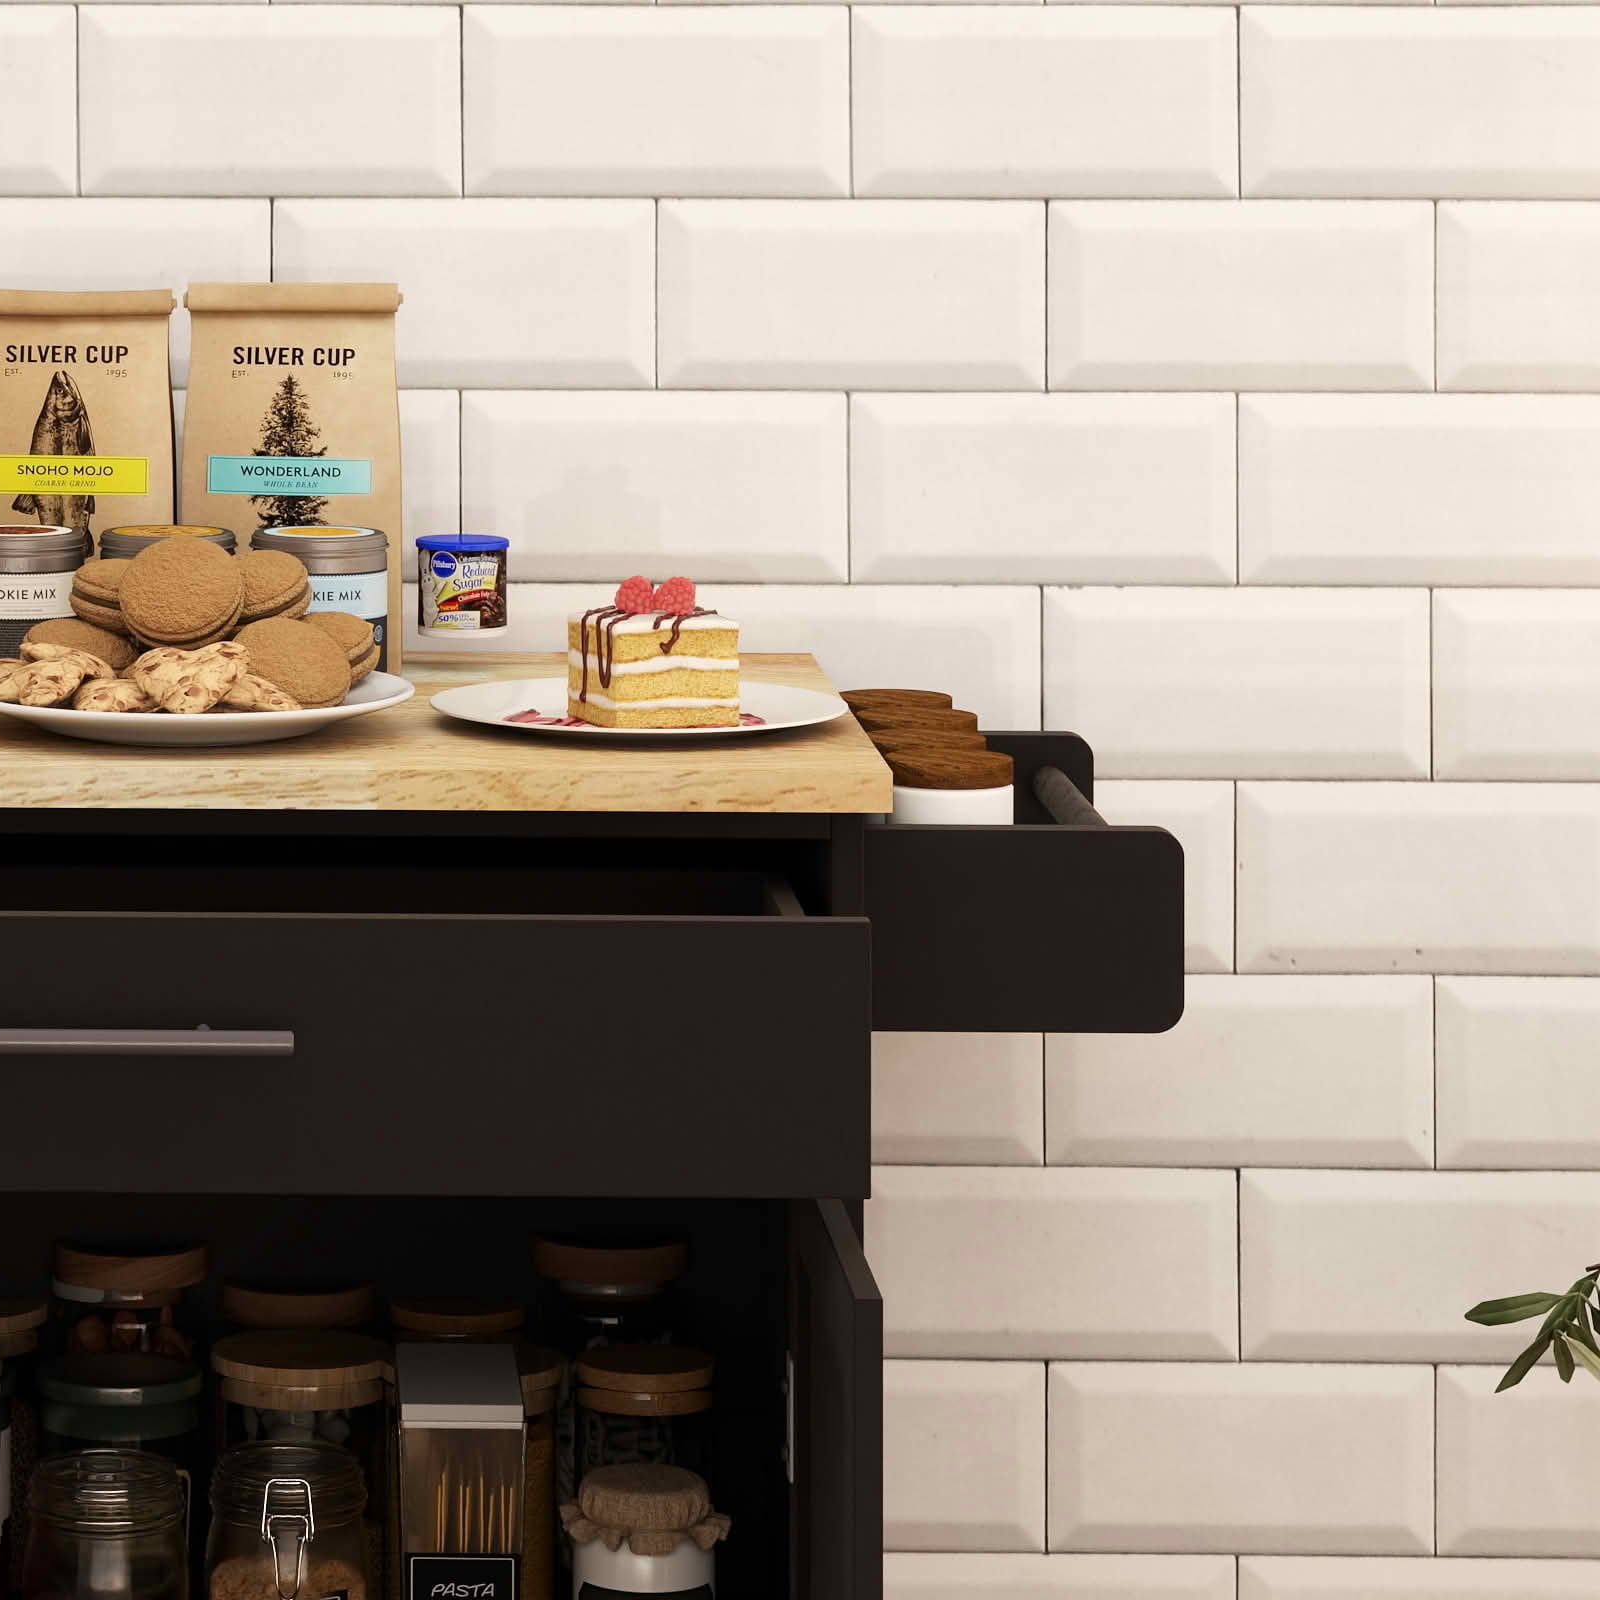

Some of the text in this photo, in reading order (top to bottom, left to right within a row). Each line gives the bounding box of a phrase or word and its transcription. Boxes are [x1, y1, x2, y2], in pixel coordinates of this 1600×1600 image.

[5, 345, 128, 363] SILVER CUP
[233, 346, 355, 366] SILVER CUP
[17, 464, 114, 477] SNOHO MOJO
[240, 465, 341, 478] WONDERLAND
[453, 578, 482, 592] Sugar
[33, 589, 57, 600] MIX
[312, 590, 361, 601] KIE MIX
[430, 1582, 495, 1598] PASTA
